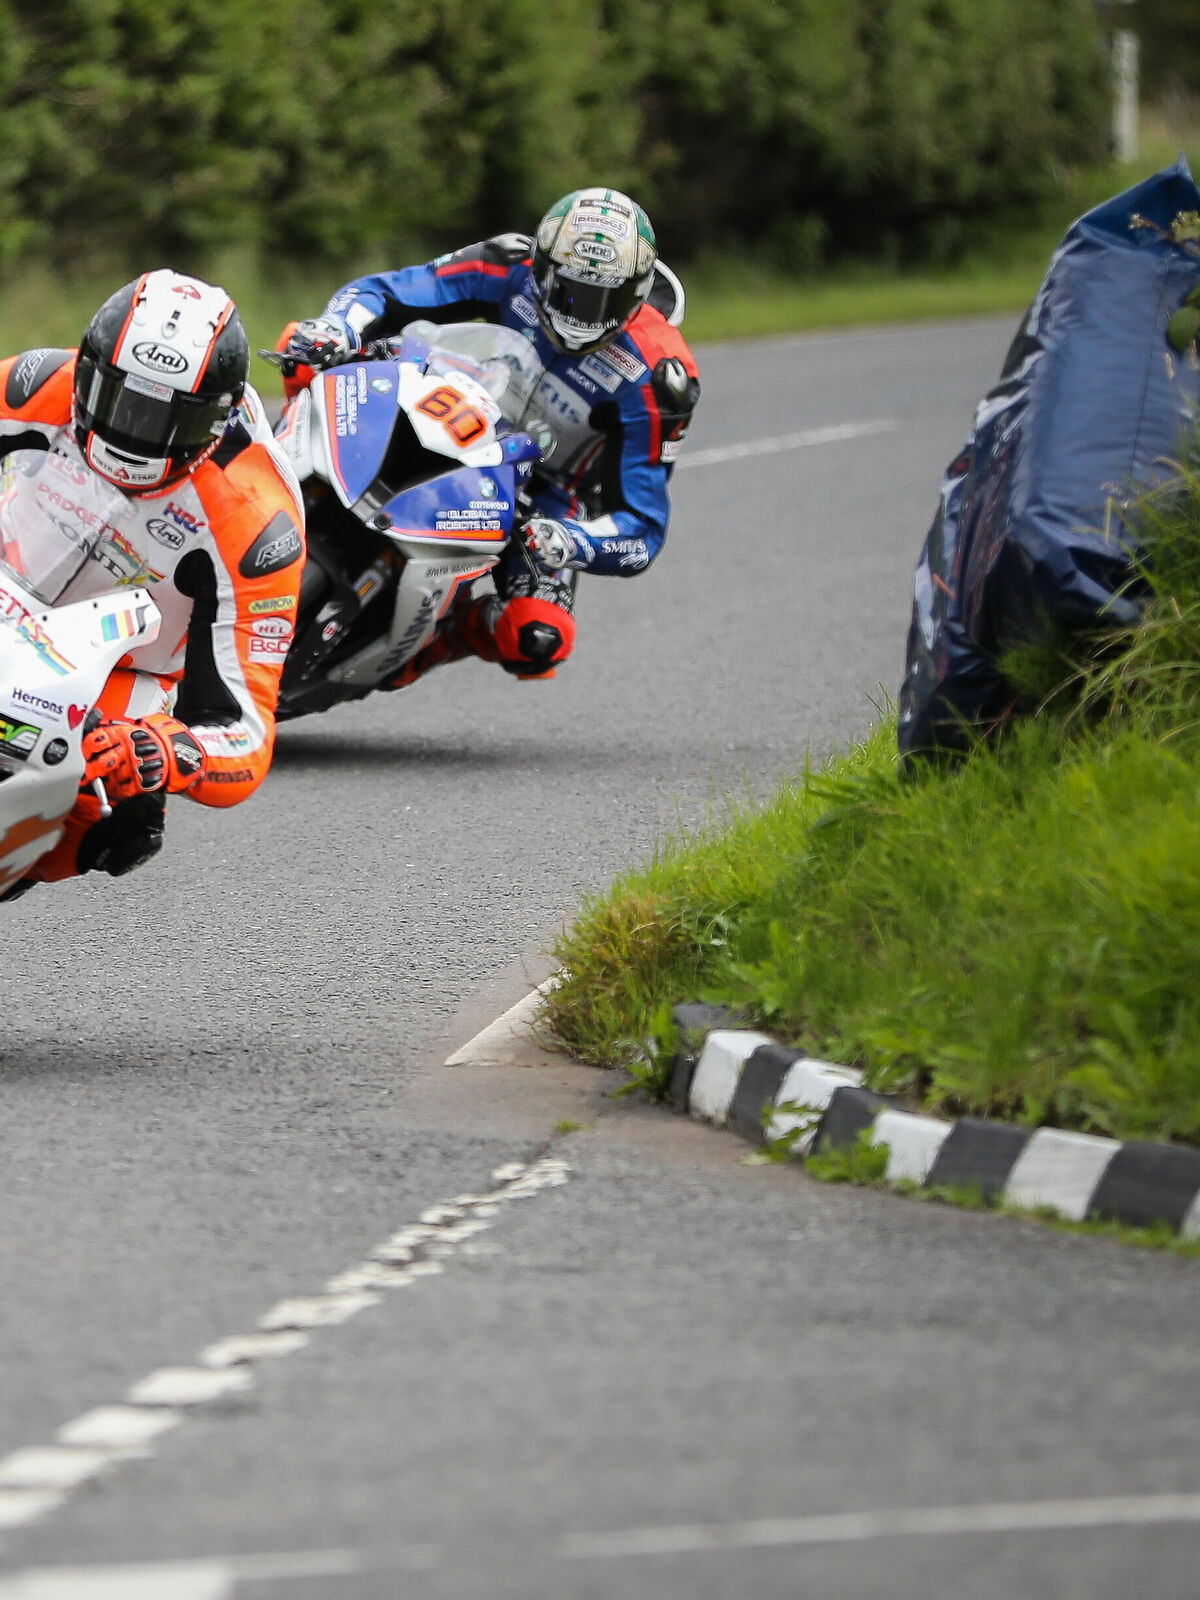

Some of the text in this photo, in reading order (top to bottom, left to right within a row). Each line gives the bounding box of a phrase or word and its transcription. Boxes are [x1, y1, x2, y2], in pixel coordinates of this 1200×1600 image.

[136, 344, 182, 368] Arai
[415, 385, 488, 448] 60
[150, 523, 184, 546] Arai
[259, 626, 283, 634] HEL
[12, 687, 64, 715] Herrons
